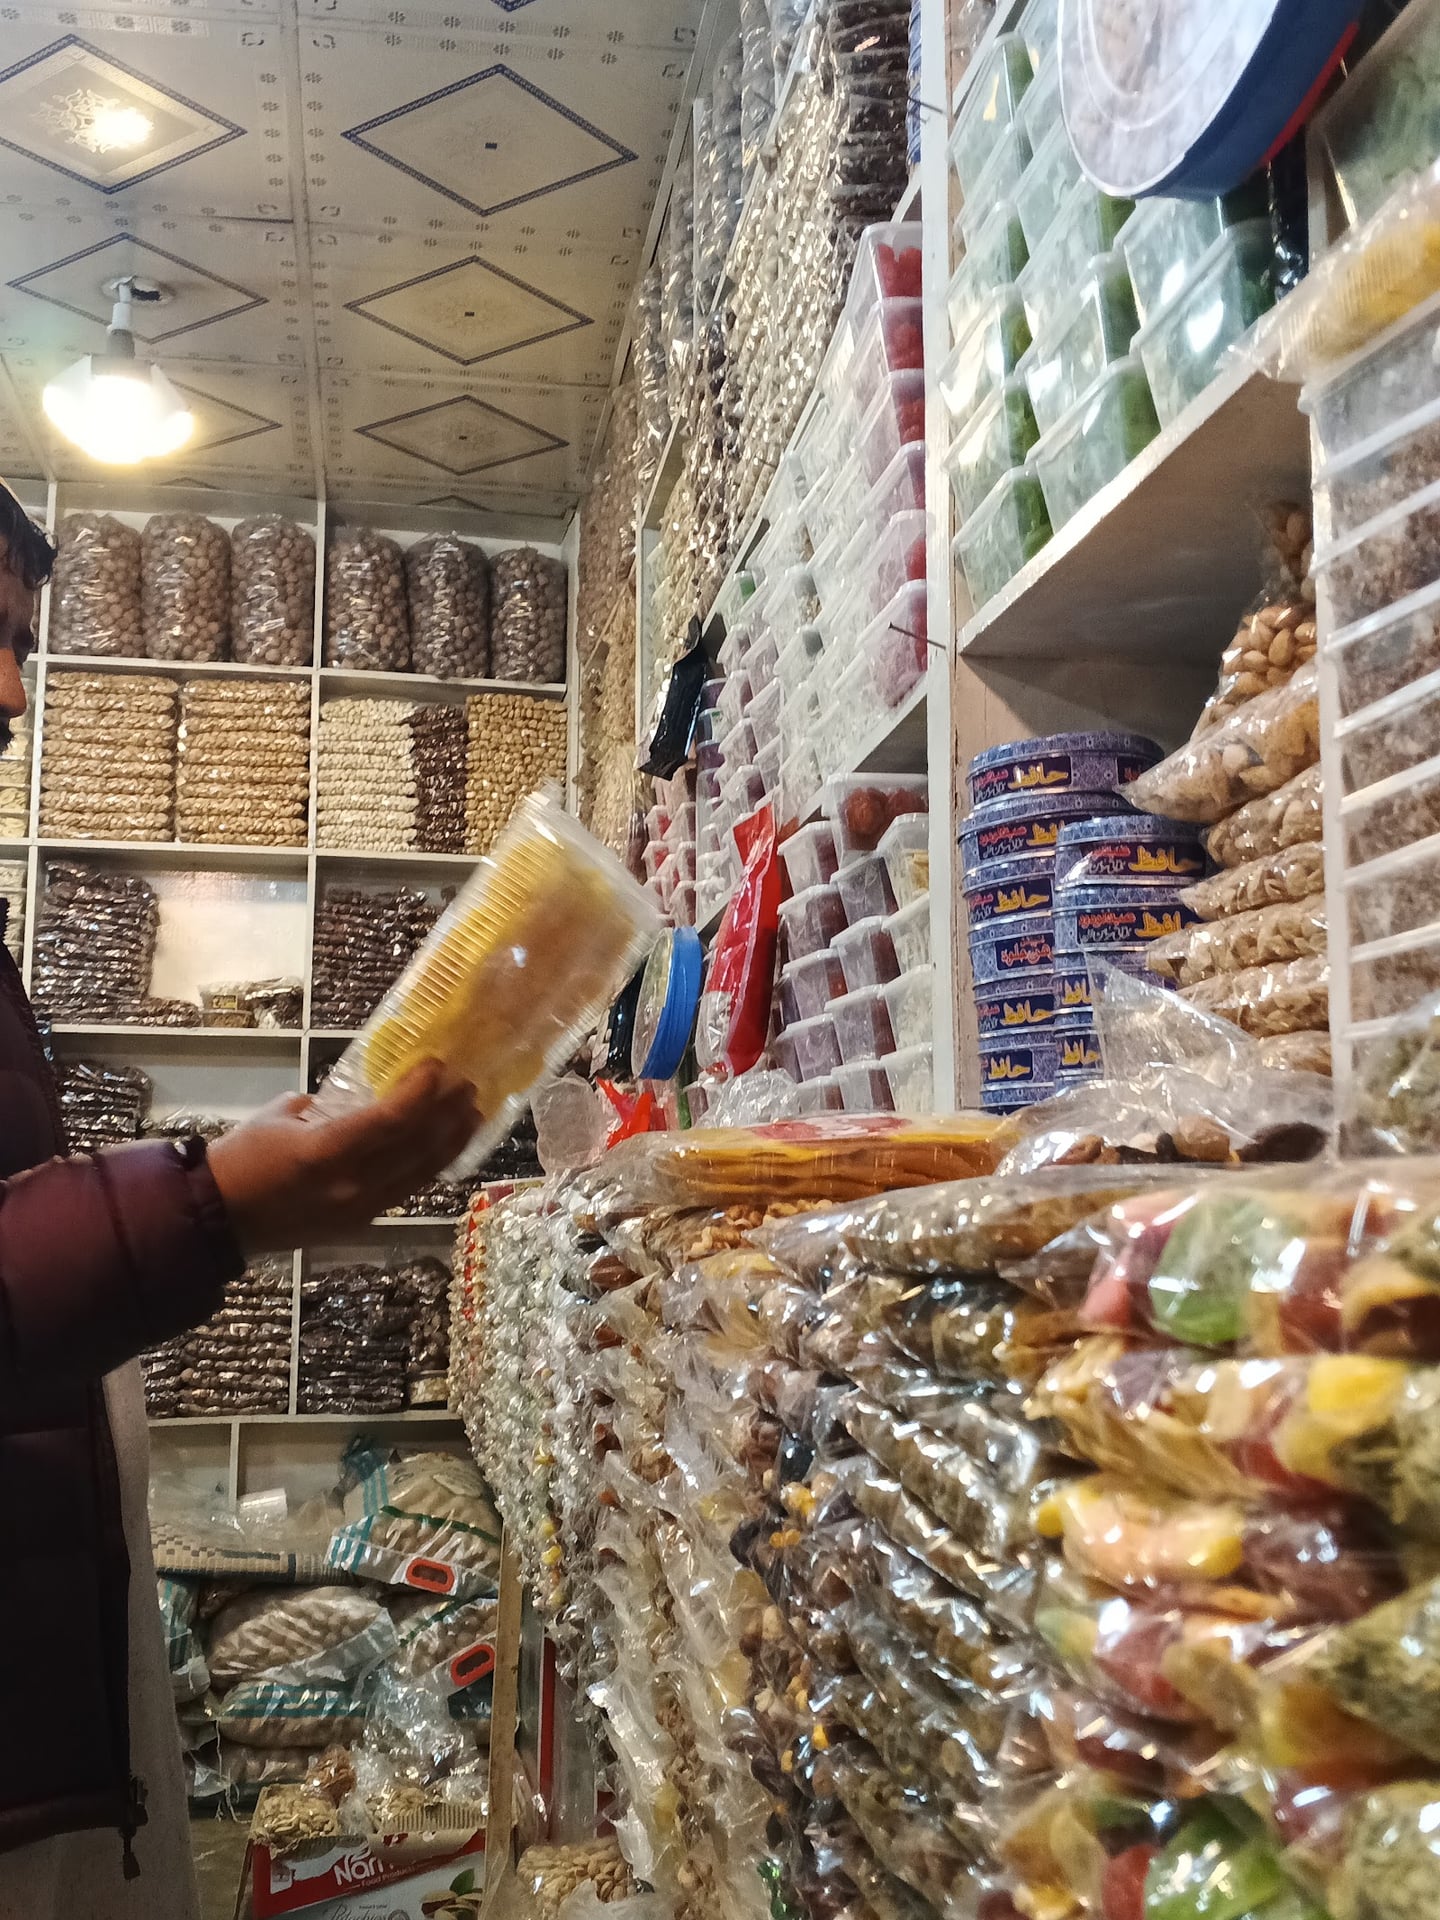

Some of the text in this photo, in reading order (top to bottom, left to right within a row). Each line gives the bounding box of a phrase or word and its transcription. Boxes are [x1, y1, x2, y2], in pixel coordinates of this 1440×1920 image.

[1008, 762, 1069, 790] حافظ
[993, 886, 1050, 916] حافظ
[1134, 910, 1184, 939] افظ
[1000, 999, 1054, 1027] حافظ
[988, 1054, 1031, 1080] حافظ
